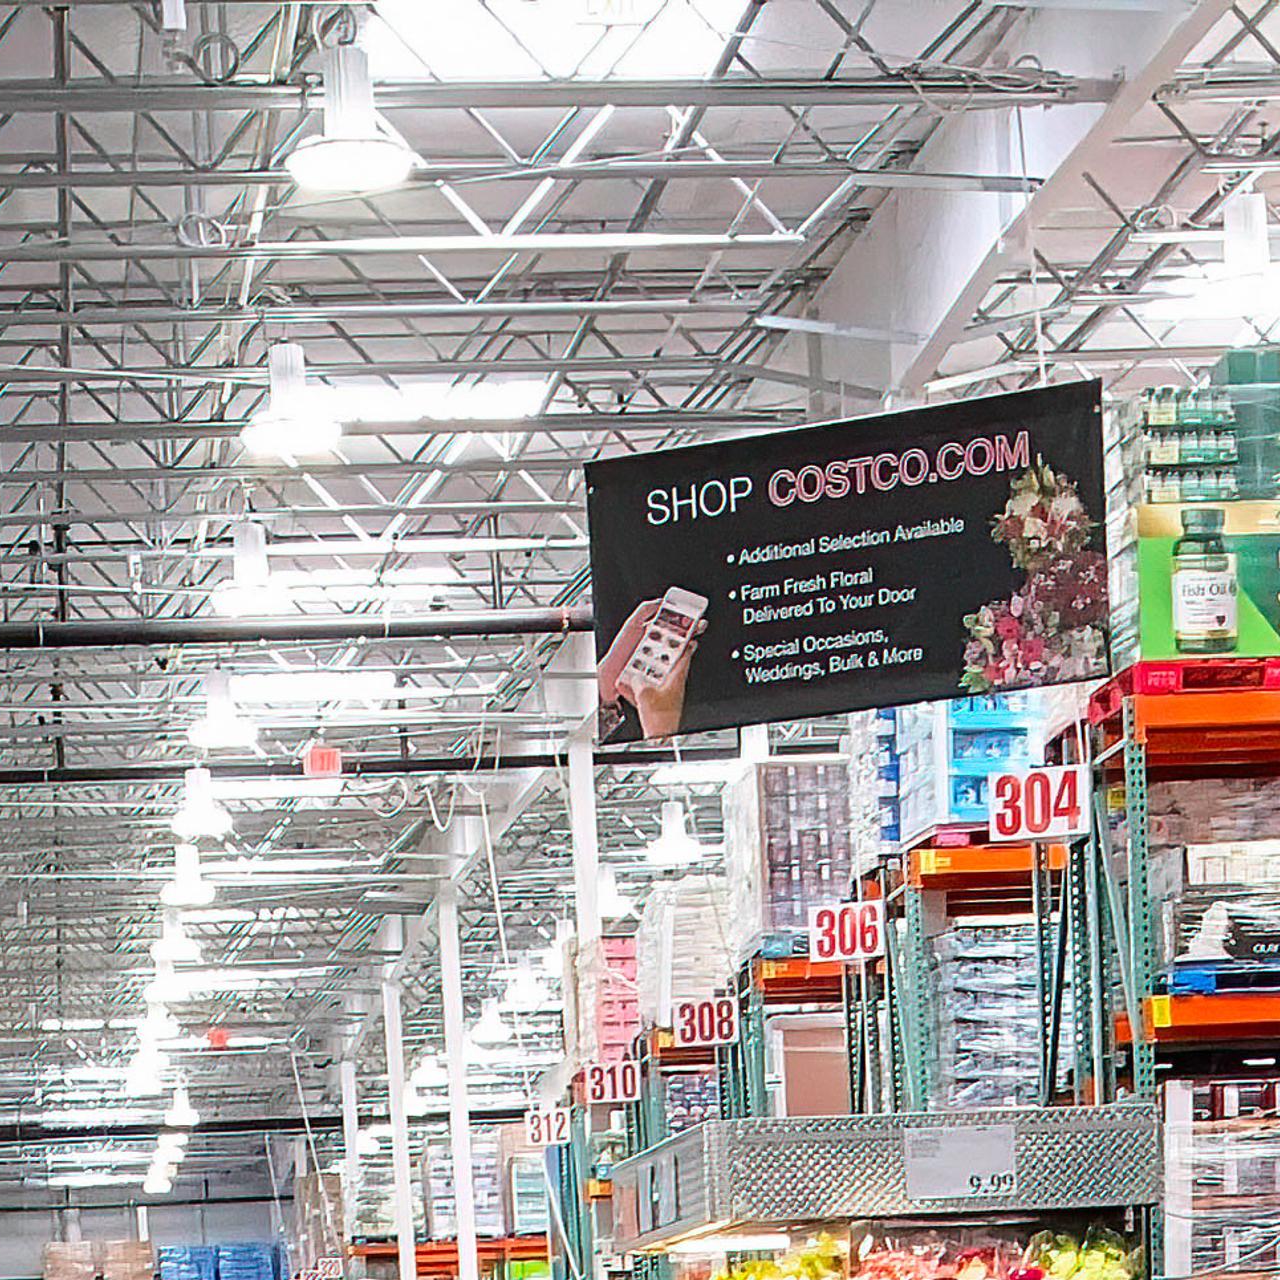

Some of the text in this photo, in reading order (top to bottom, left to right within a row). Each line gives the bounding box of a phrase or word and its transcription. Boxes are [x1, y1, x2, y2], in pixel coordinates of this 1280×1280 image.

[646, 431, 1031, 526] SHOP COSTCO.COM
[738, 517, 965, 565] Additional Selection Available
[740, 567, 873, 601] Farm Fresh Floral
[743, 586, 917, 624] Delivered To Your Door
[744, 629, 889, 662] Special Occasions,
[745, 646, 923, 684] Weddings, Bulk & More
[993, 770, 1082, 838] 304
[815, 910, 879, 958] 306
[679, 1002, 734, 1043] 308
[589, 1063, 636, 1101] 310
[529, 1112, 568, 1144] 312
[969, 1173, 1014, 1194] 9.99
